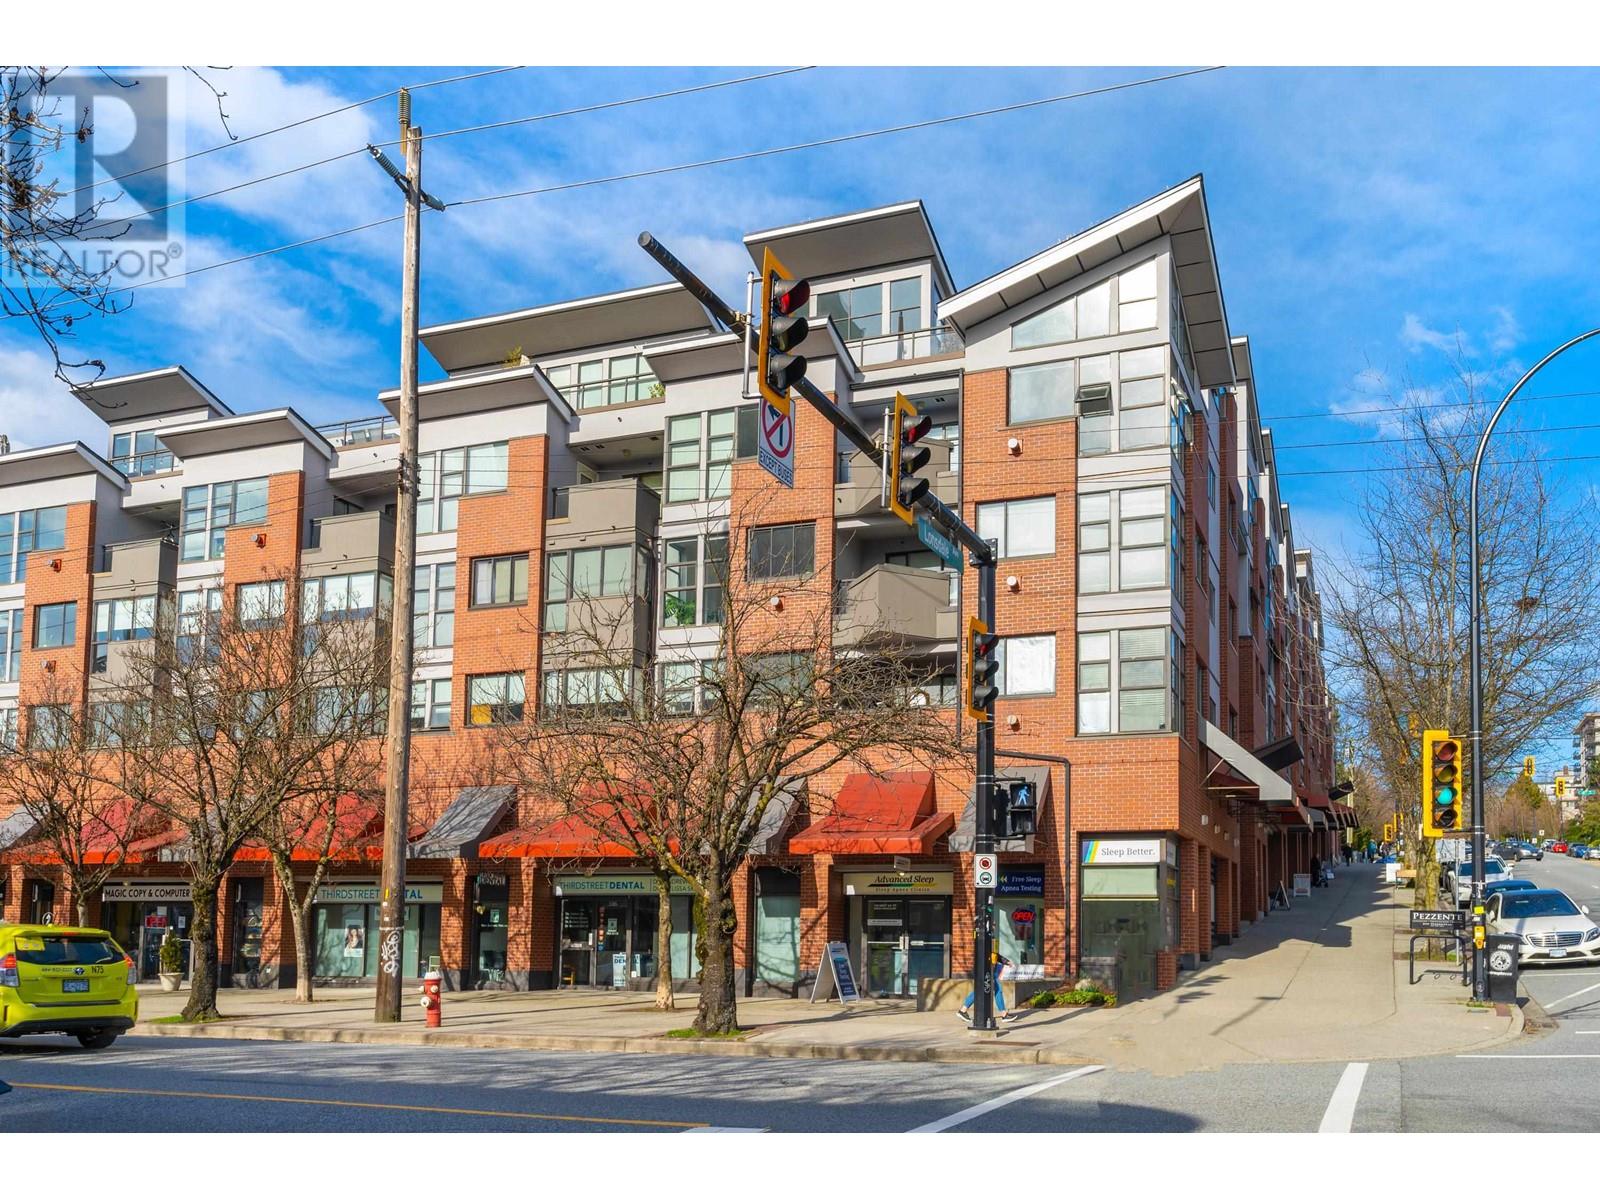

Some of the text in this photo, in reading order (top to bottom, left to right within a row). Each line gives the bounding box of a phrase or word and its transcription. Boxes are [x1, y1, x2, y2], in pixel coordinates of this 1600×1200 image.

[760, 450, 793, 485] EXCEPT BUSES
[925, 532, 949, 559] Lonsdale
[1101, 847, 1156, 857] Sleep Better.
[874, 875, 934, 883] Advanced Sleep
[1026, 876, 1041, 884] Sleep
[105, 888, 190, 897] MAGIC COPY & COMPUTER
[1012, 912, 1034, 921] OPEN
[1413, 912, 1462, 920] PEZZENTE
